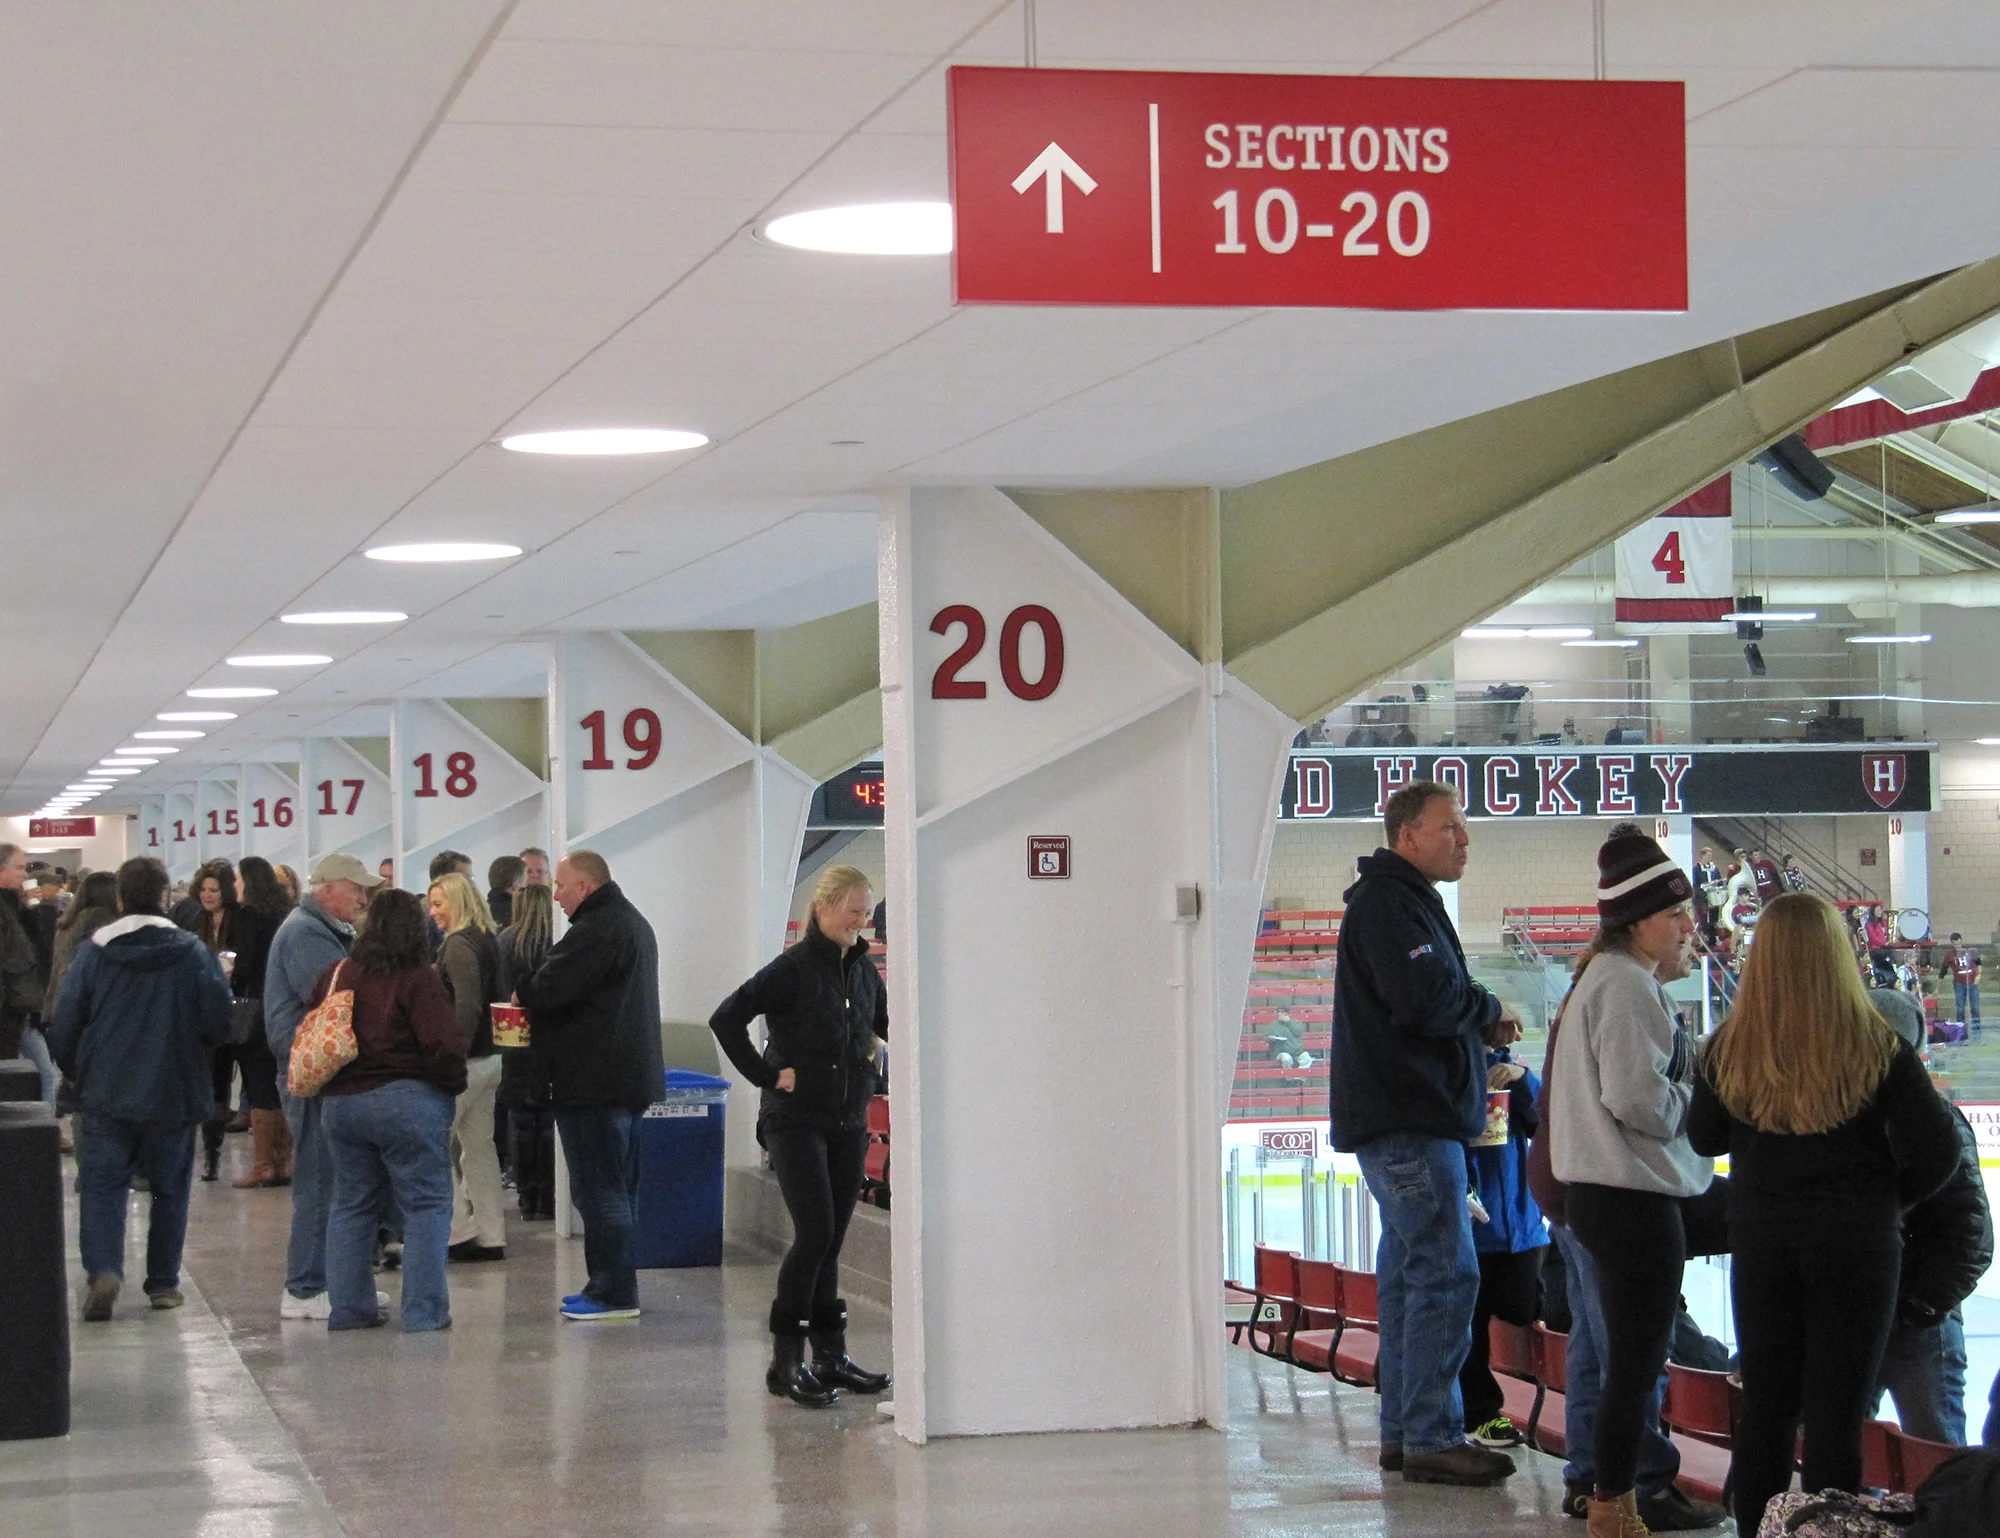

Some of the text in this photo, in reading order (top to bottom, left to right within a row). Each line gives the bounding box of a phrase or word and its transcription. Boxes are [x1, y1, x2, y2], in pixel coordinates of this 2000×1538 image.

[1203, 122, 1450, 174] SECTIONS
[1212, 187, 1432, 258] 10-20
[1651, 530, 1685, 584] 4
[929, 604, 1065, 701] 20
[580, 707, 662, 771] 19
[413, 751, 478, 798] 18
[1277, 755, 1692, 818] D HOCKEY
[1872, 759, 1896, 792] H
[253, 796, 294, 828] 16
[317, 779, 365, 816] 17
[207, 809, 240, 835] 15
[1657, 820, 1669, 838] 10
[1890, 818, 1902, 835] 10
[1032, 841, 1065, 849] Reserved
[1270, 1132, 1312, 1149] COOP
[1264, 1306, 1275, 1319] G
